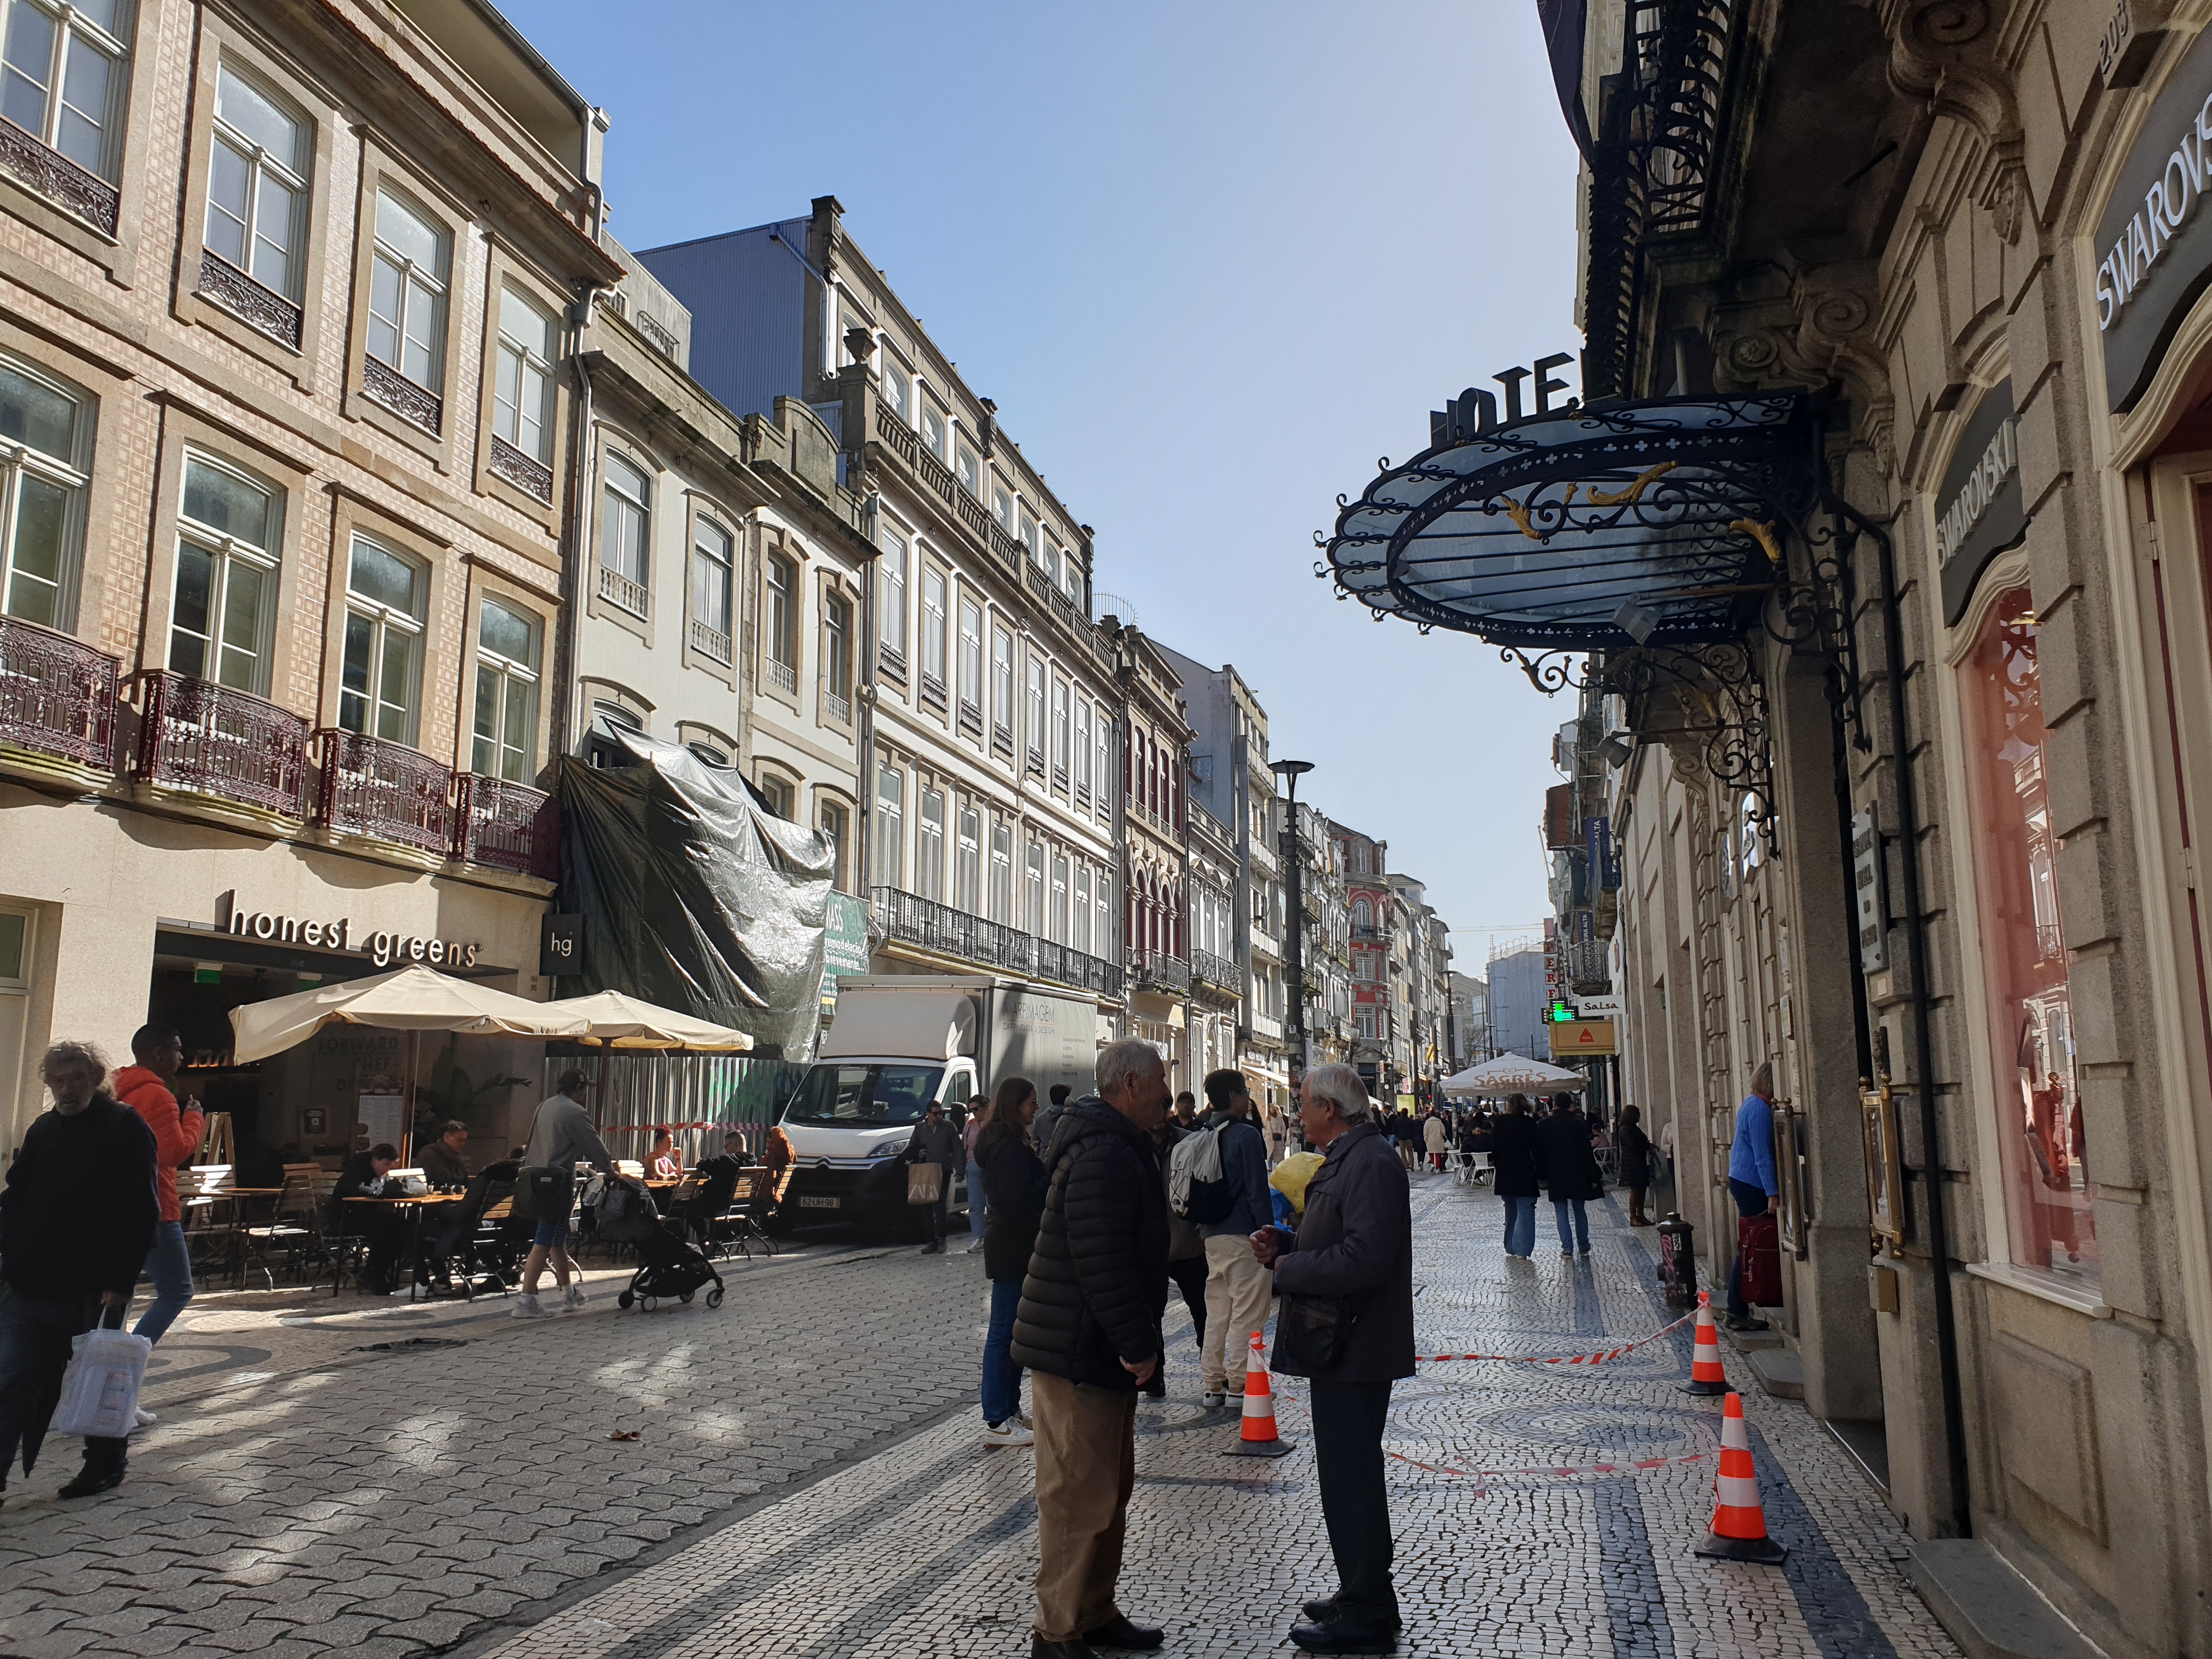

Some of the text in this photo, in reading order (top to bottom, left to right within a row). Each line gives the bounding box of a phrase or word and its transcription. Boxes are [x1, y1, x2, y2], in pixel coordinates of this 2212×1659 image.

[1430, 352, 1576, 448] HOTE
[1937, 417, 2017, 571] SWAROVSKI
[229, 889, 353, 950] honest
[551, 932, 572, 956] hg
[1545, 944, 1556, 998] PERF
[1003, 1023, 1032, 1032] CARPINTARIA
[1038, 1026, 1055, 1034] DESIGN
[1474, 1072, 1547, 1088] SAGRES
